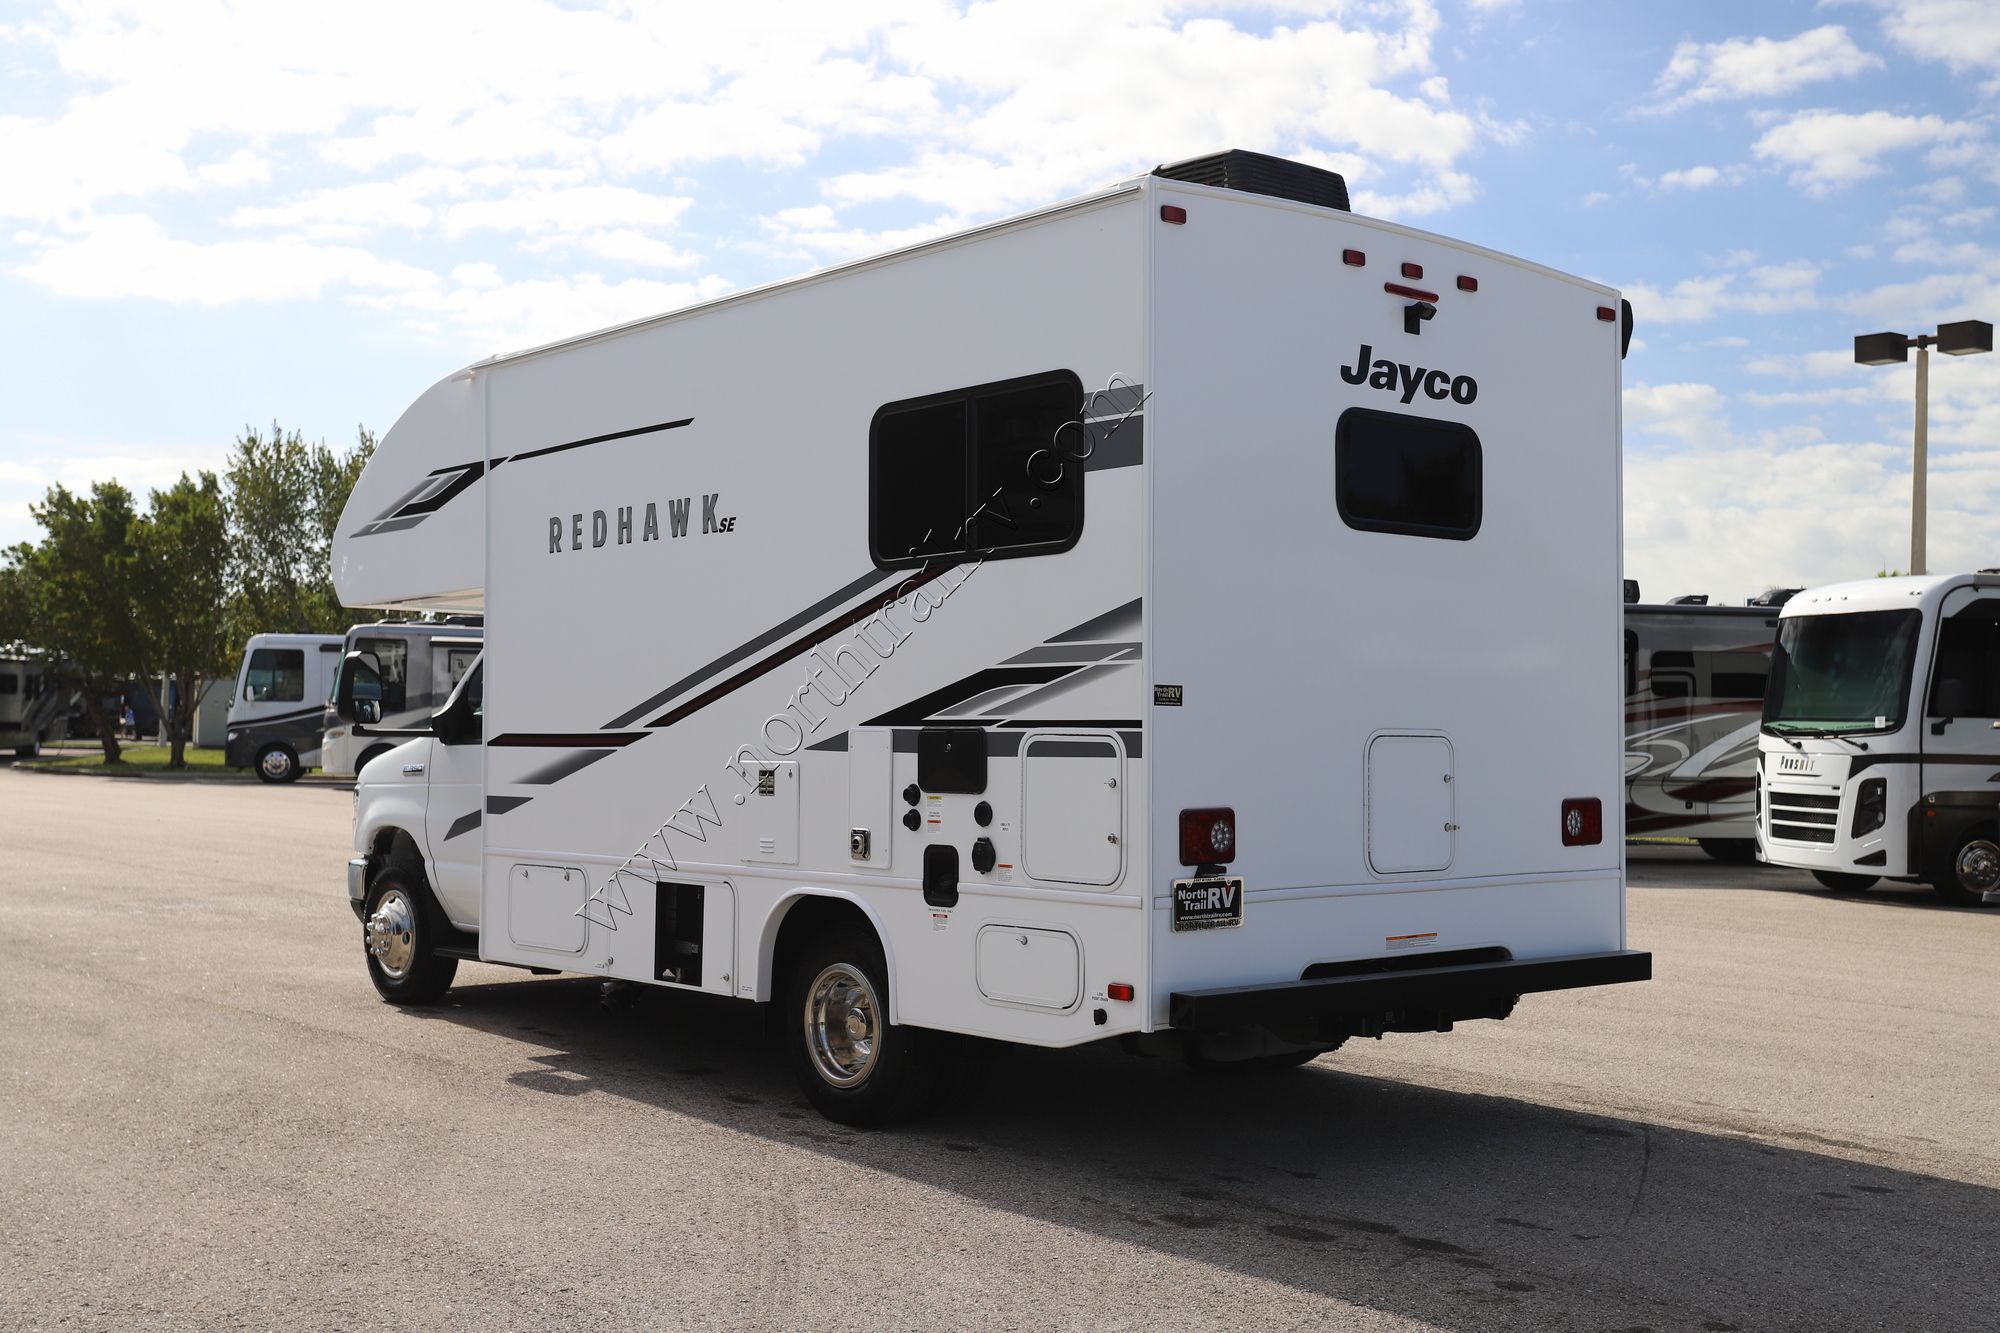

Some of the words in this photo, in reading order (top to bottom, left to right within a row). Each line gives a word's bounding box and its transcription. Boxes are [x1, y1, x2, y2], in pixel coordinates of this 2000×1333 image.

[1340, 343, 1478, 405] Jayco
[548, 493, 719, 554] REDHAWK
[718, 516, 736, 533] SE
[1168, 687, 1181, 698] RV
[1178, 888, 1207, 900] North
[1207, 886, 1235, 909] RV
[1183, 899, 1207, 911] Trail
[1180, 912, 1232, 920] www.northtrailrv.com
